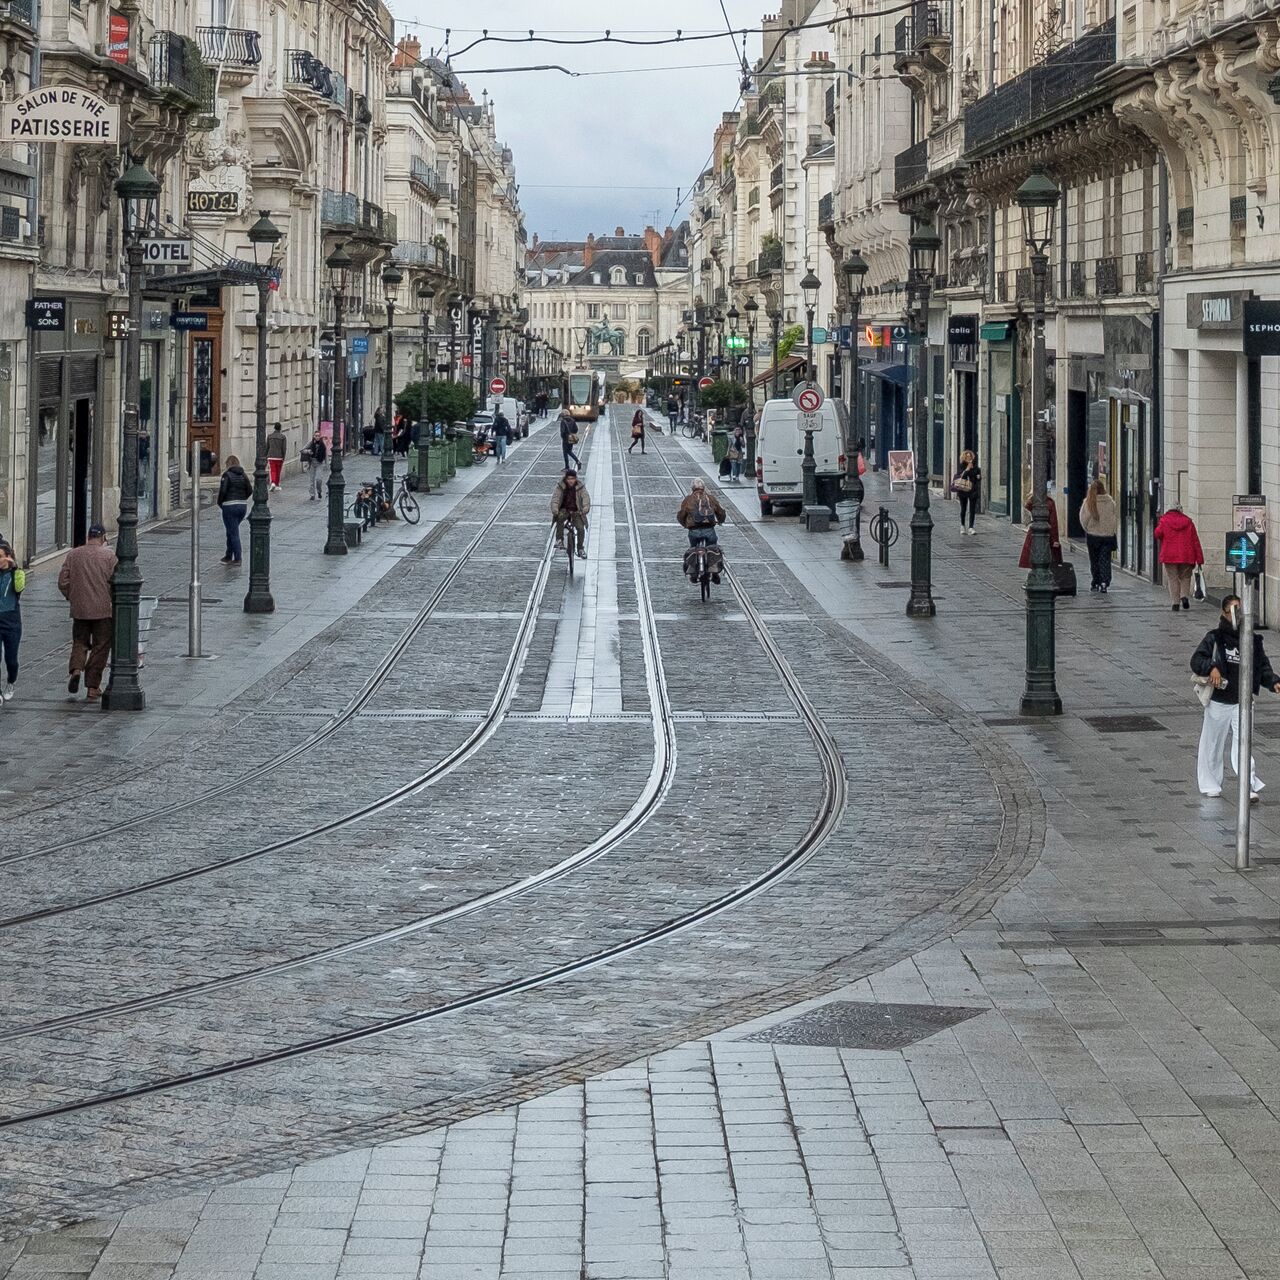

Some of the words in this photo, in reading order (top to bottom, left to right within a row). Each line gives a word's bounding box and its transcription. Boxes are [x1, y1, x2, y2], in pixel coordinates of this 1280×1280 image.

[17, 91, 57, 116] SALON
[62, 90, 77, 104] DE
[81, 95, 105, 117] THE
[11, 118, 109, 137] PATISSERIE
[189, 192, 238, 211] HOTEL
[34, 302, 63, 310] FATHER
[1202, 298, 1231, 322] SEPHORA
[38, 318, 59, 326] SONS
